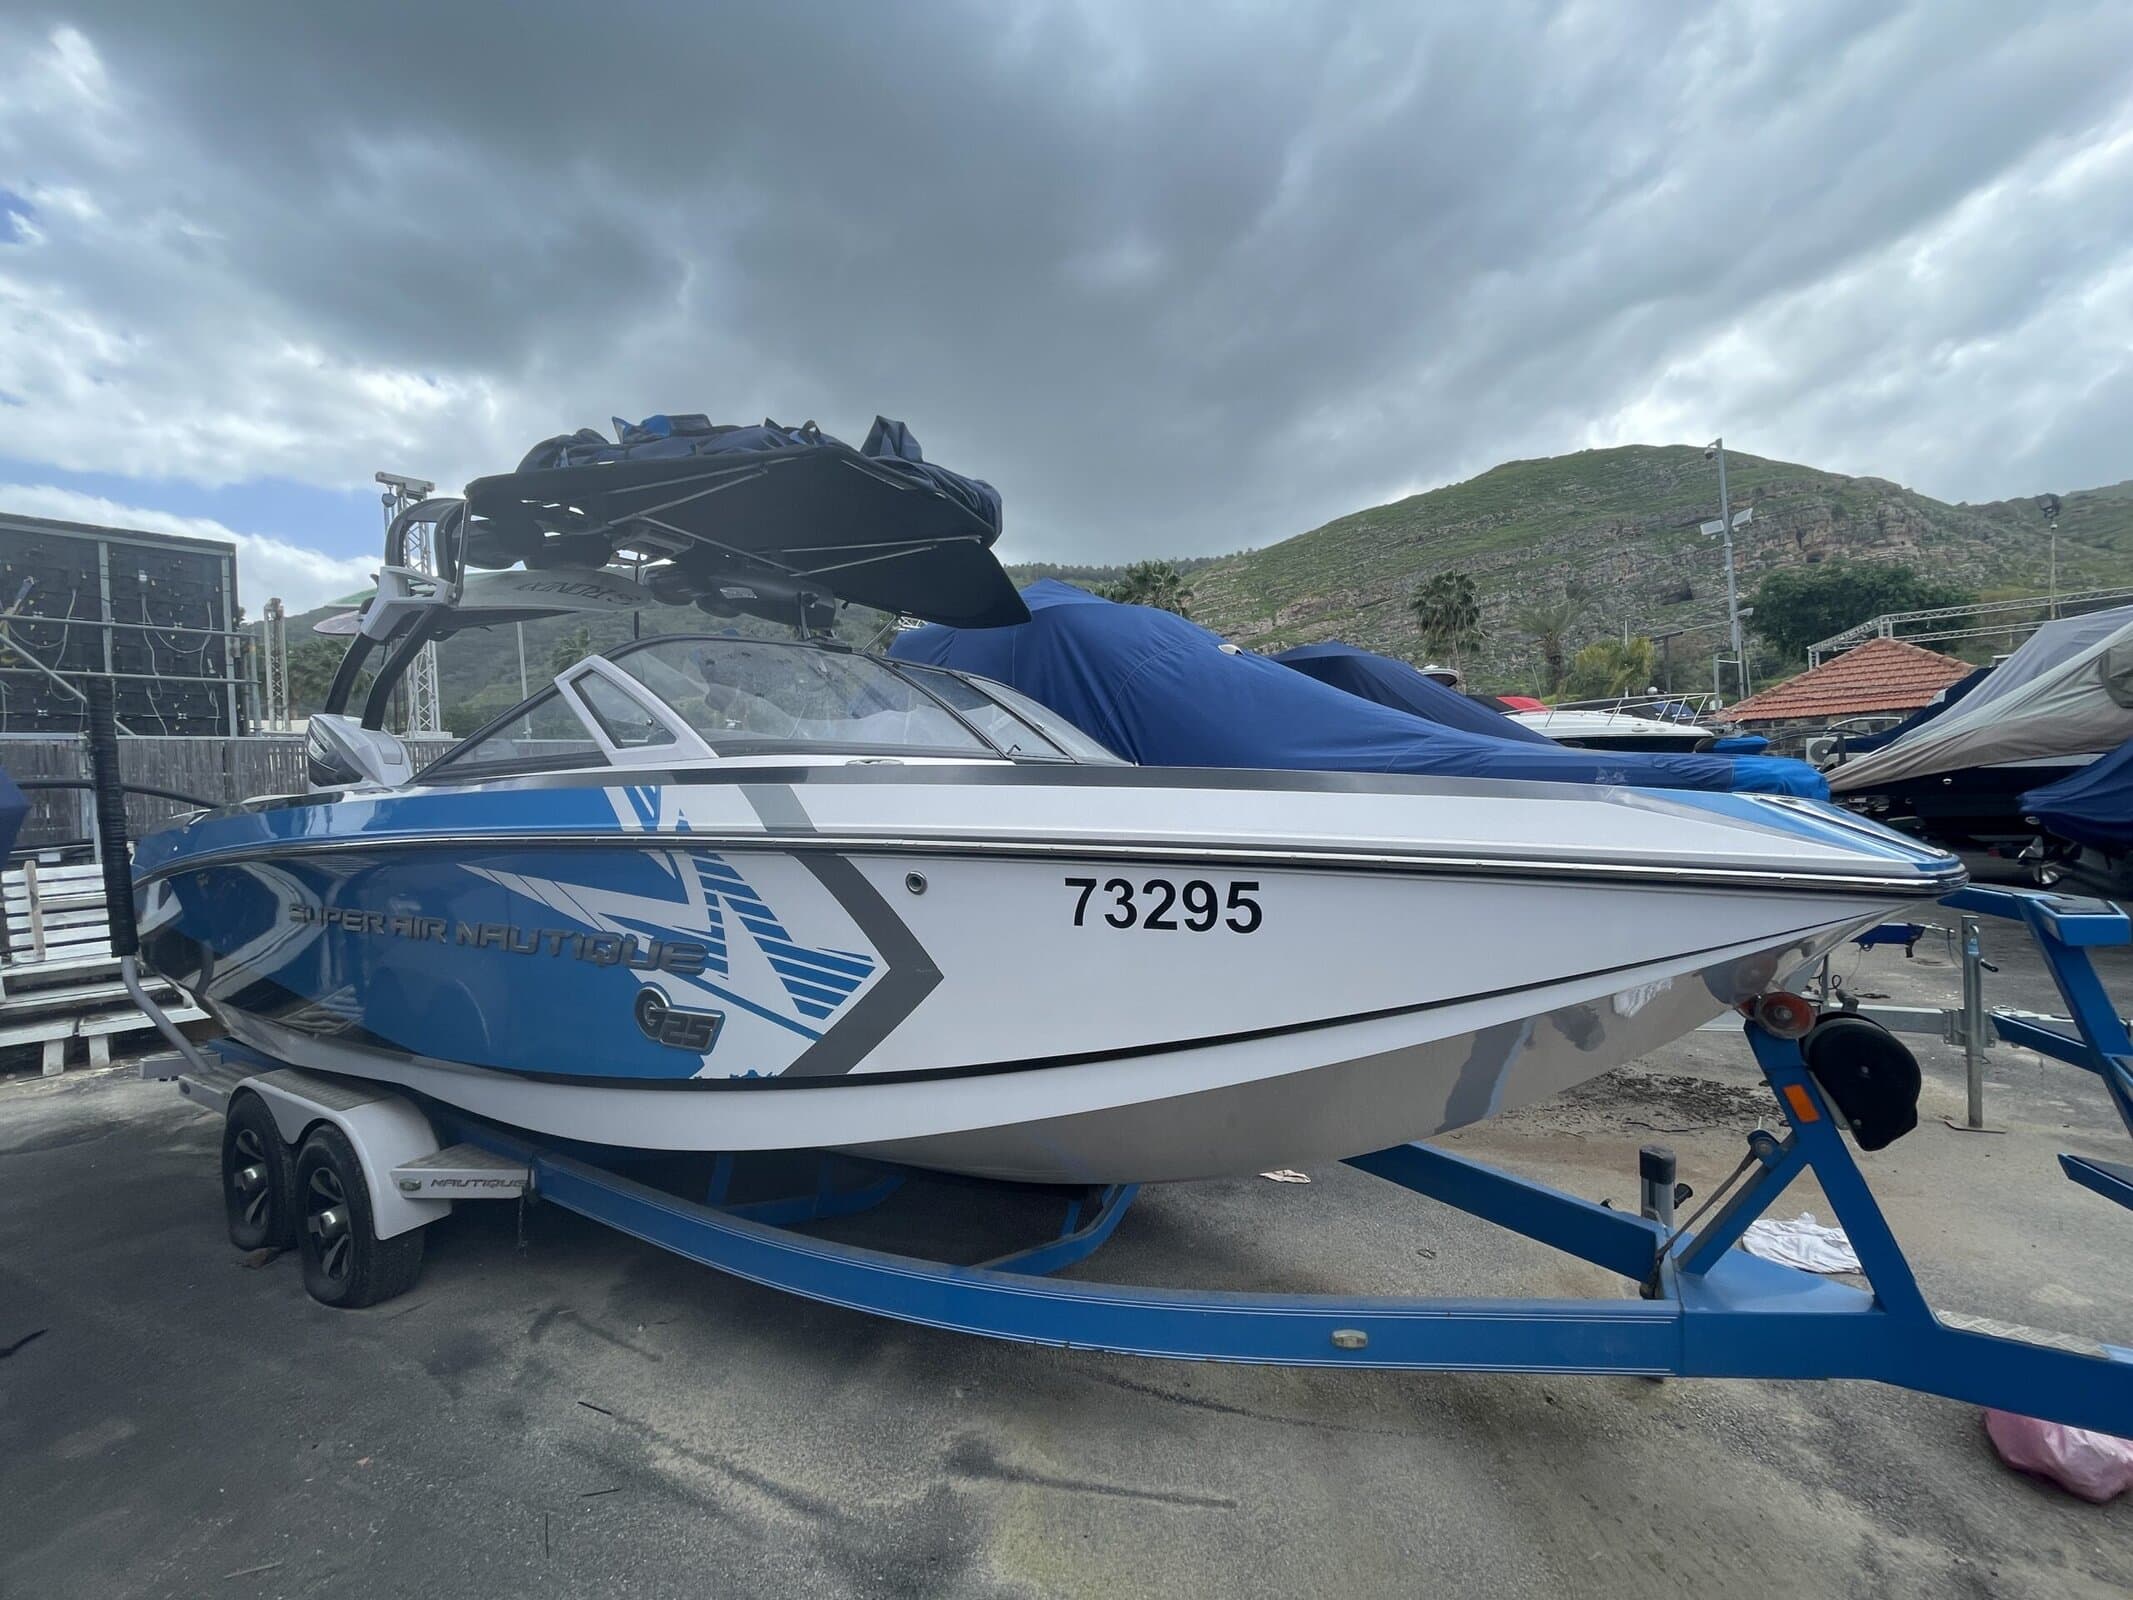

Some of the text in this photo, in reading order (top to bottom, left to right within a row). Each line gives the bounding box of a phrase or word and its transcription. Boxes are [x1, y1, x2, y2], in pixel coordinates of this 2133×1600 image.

[289, 903, 708, 975] SUPER AIR NAUTIQUE
[1065, 878, 1262, 934] 73295
[635, 984, 724, 1053] G25
